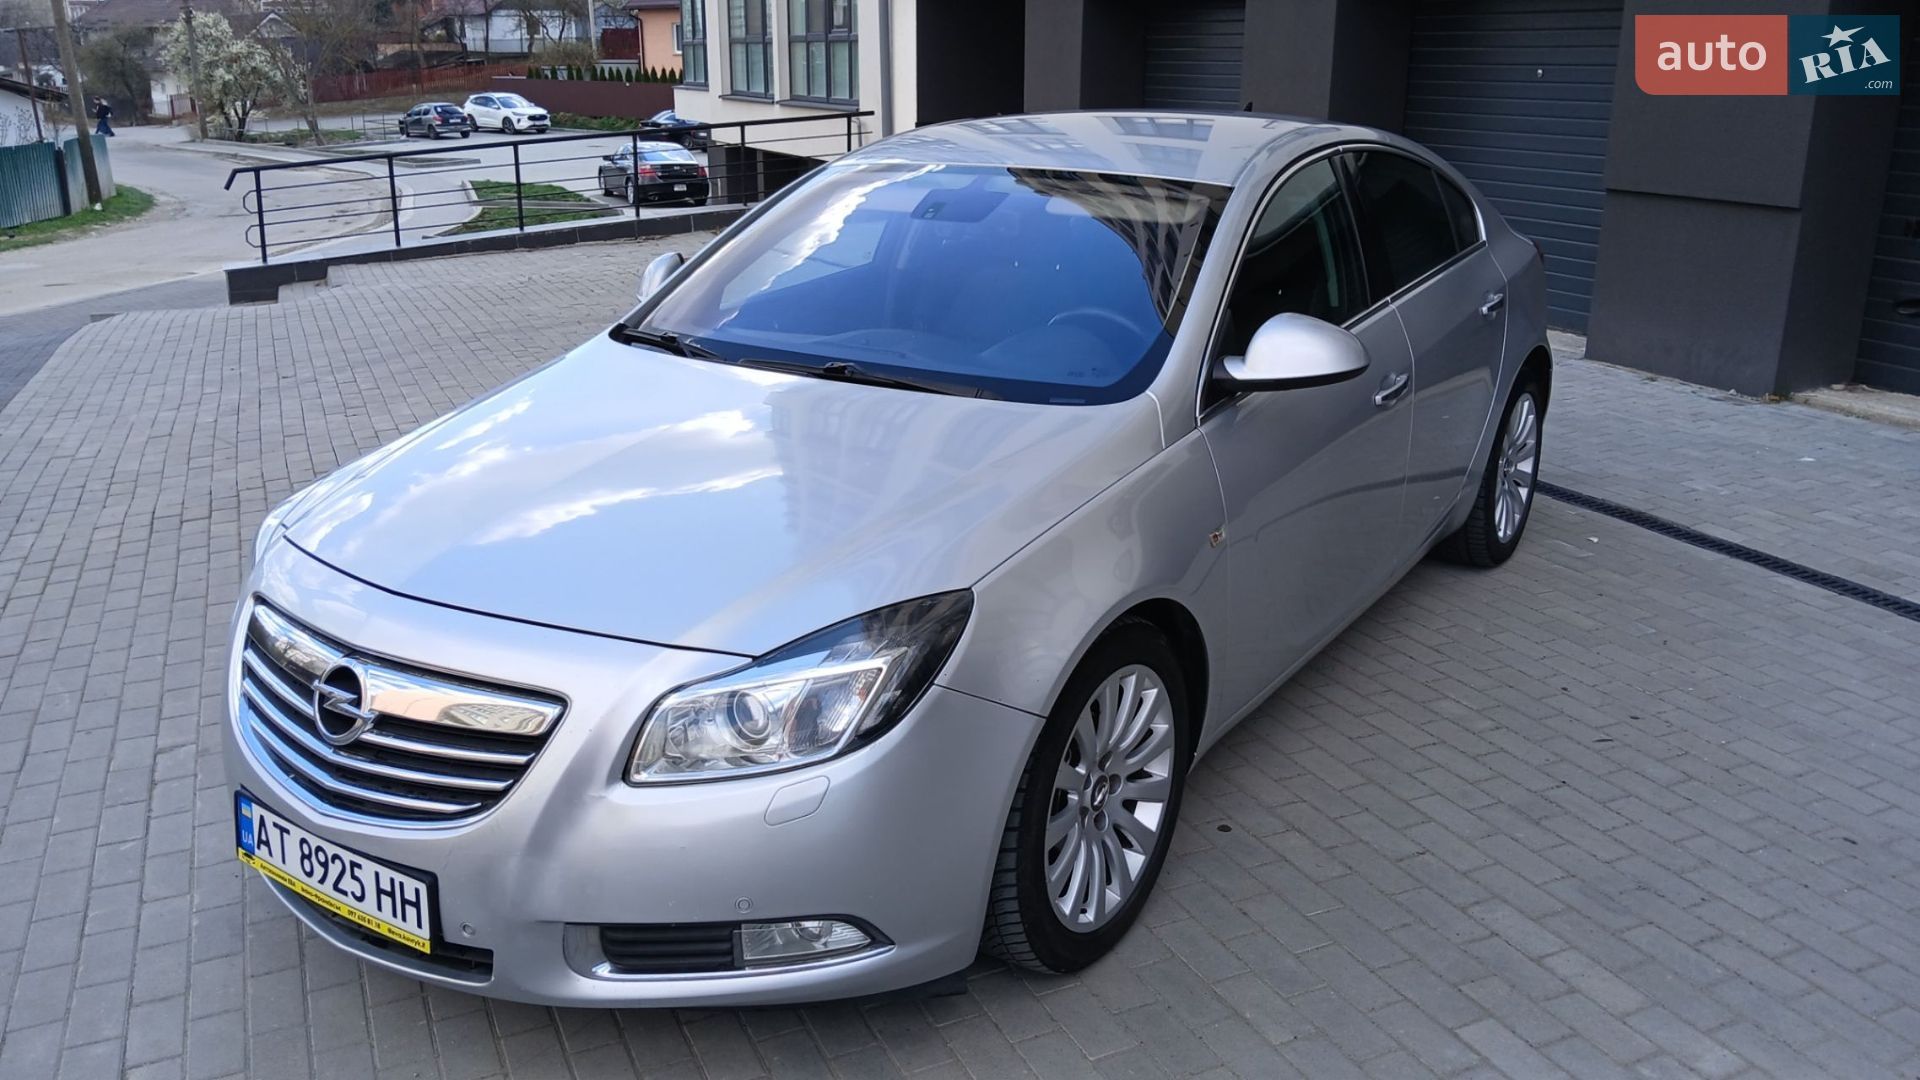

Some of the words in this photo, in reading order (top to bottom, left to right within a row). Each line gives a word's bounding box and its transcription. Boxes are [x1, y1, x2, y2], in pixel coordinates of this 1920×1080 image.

[242, 830, 254, 847] UA
[257, 814, 291, 865] AT
[299, 837, 366, 903] 8925
[374, 870, 423, 929] HH
